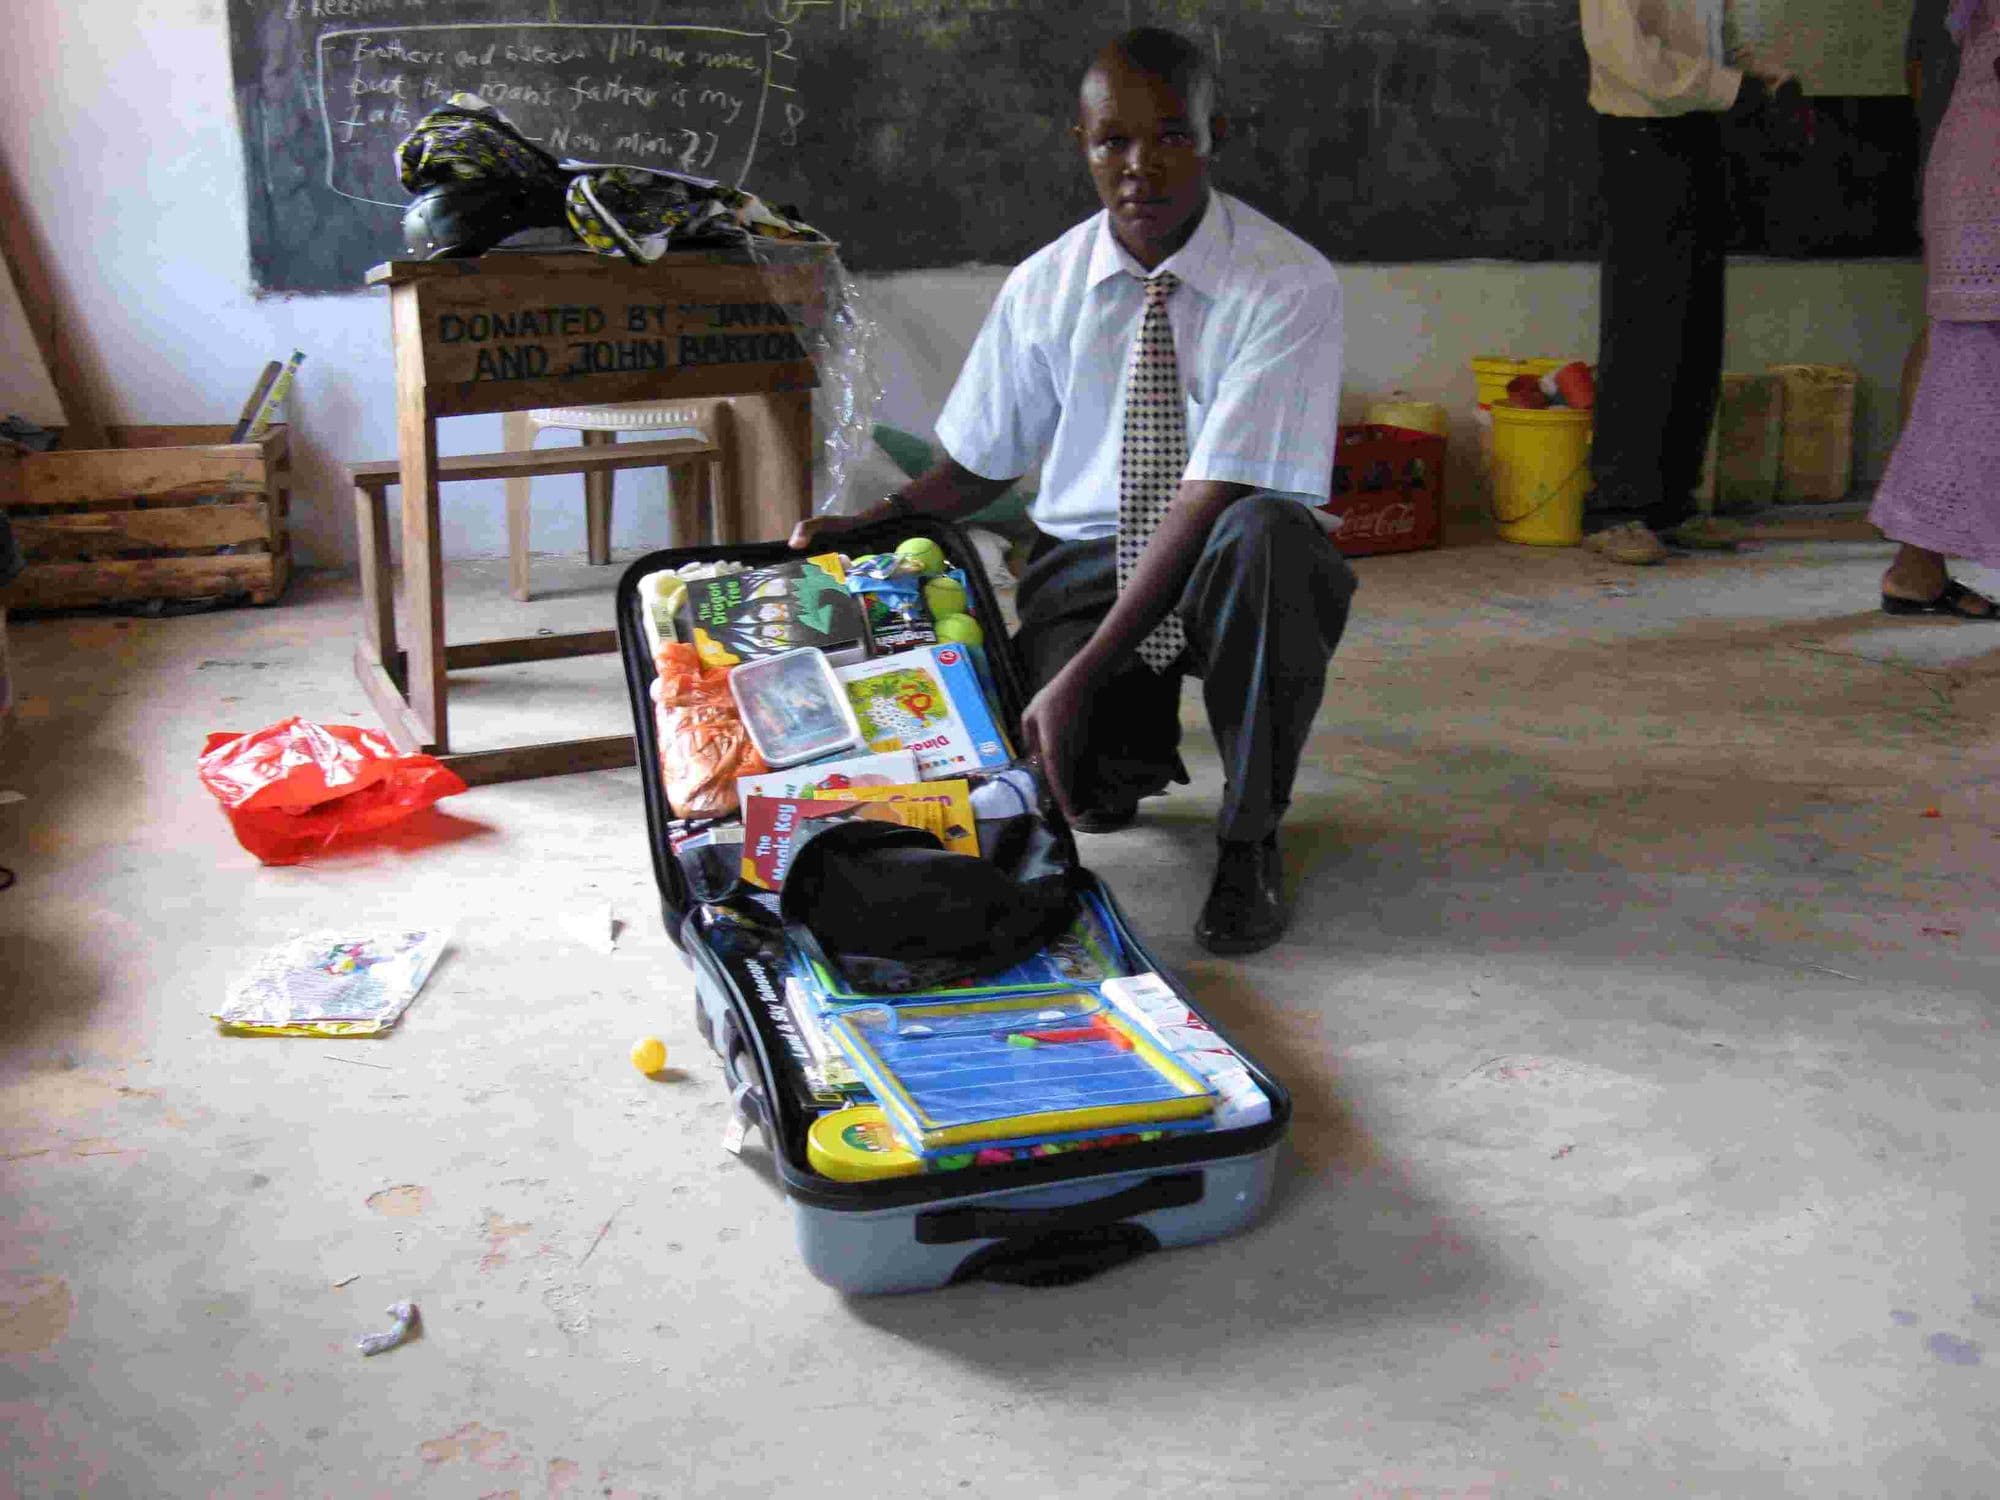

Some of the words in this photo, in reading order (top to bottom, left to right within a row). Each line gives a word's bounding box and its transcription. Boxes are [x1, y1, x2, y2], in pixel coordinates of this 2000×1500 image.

[700, 89, 743, 123] my
[440, 306, 606, 344] DONATED
[627, 302, 668, 333] BY
[474, 344, 549, 382] AND
[559, 338, 668, 379] JOHN
[708, 582, 727, 626] Dragon
[725, 580, 742, 608] Tree
[773, 803, 798, 833] Key
[755, 834, 772, 857] The
